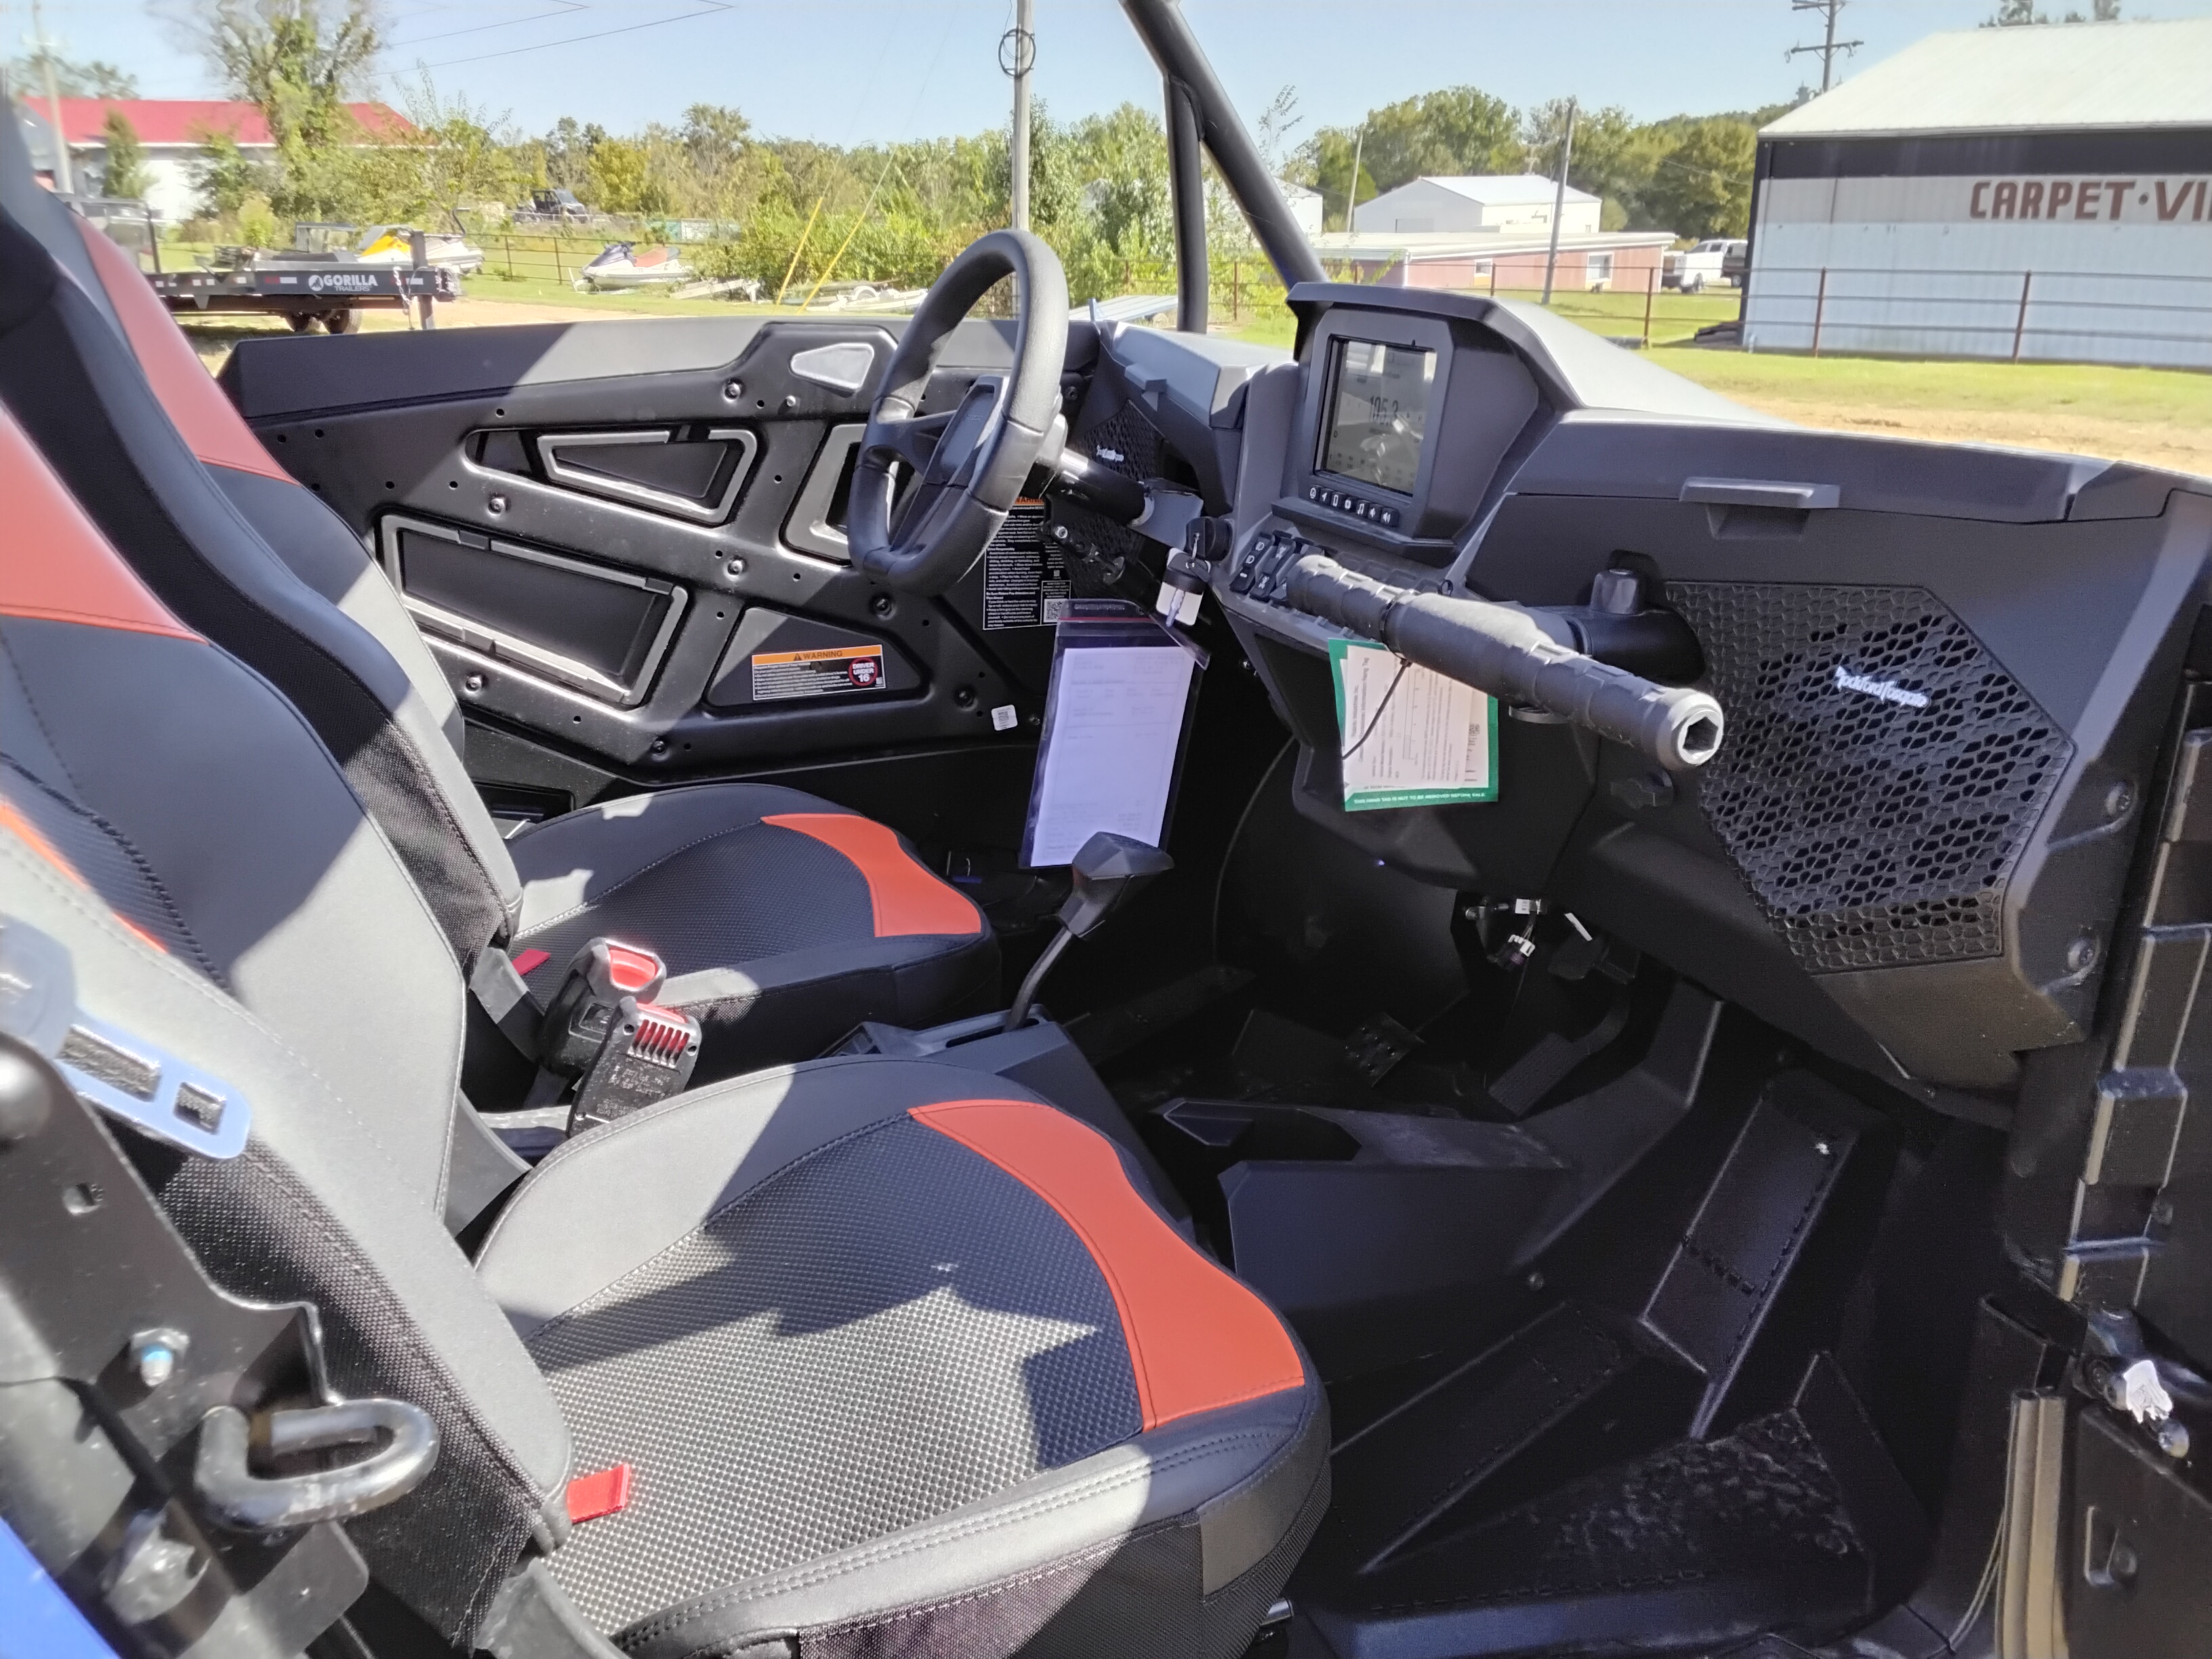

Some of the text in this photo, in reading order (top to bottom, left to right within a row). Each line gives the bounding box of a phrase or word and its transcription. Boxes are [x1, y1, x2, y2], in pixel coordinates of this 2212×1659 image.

[1970, 180, 2136, 221] CARPET
[323, 274, 379, 287] GORILLA
[802, 650, 842, 660] WARNING
[858, 674, 870, 682] 16
